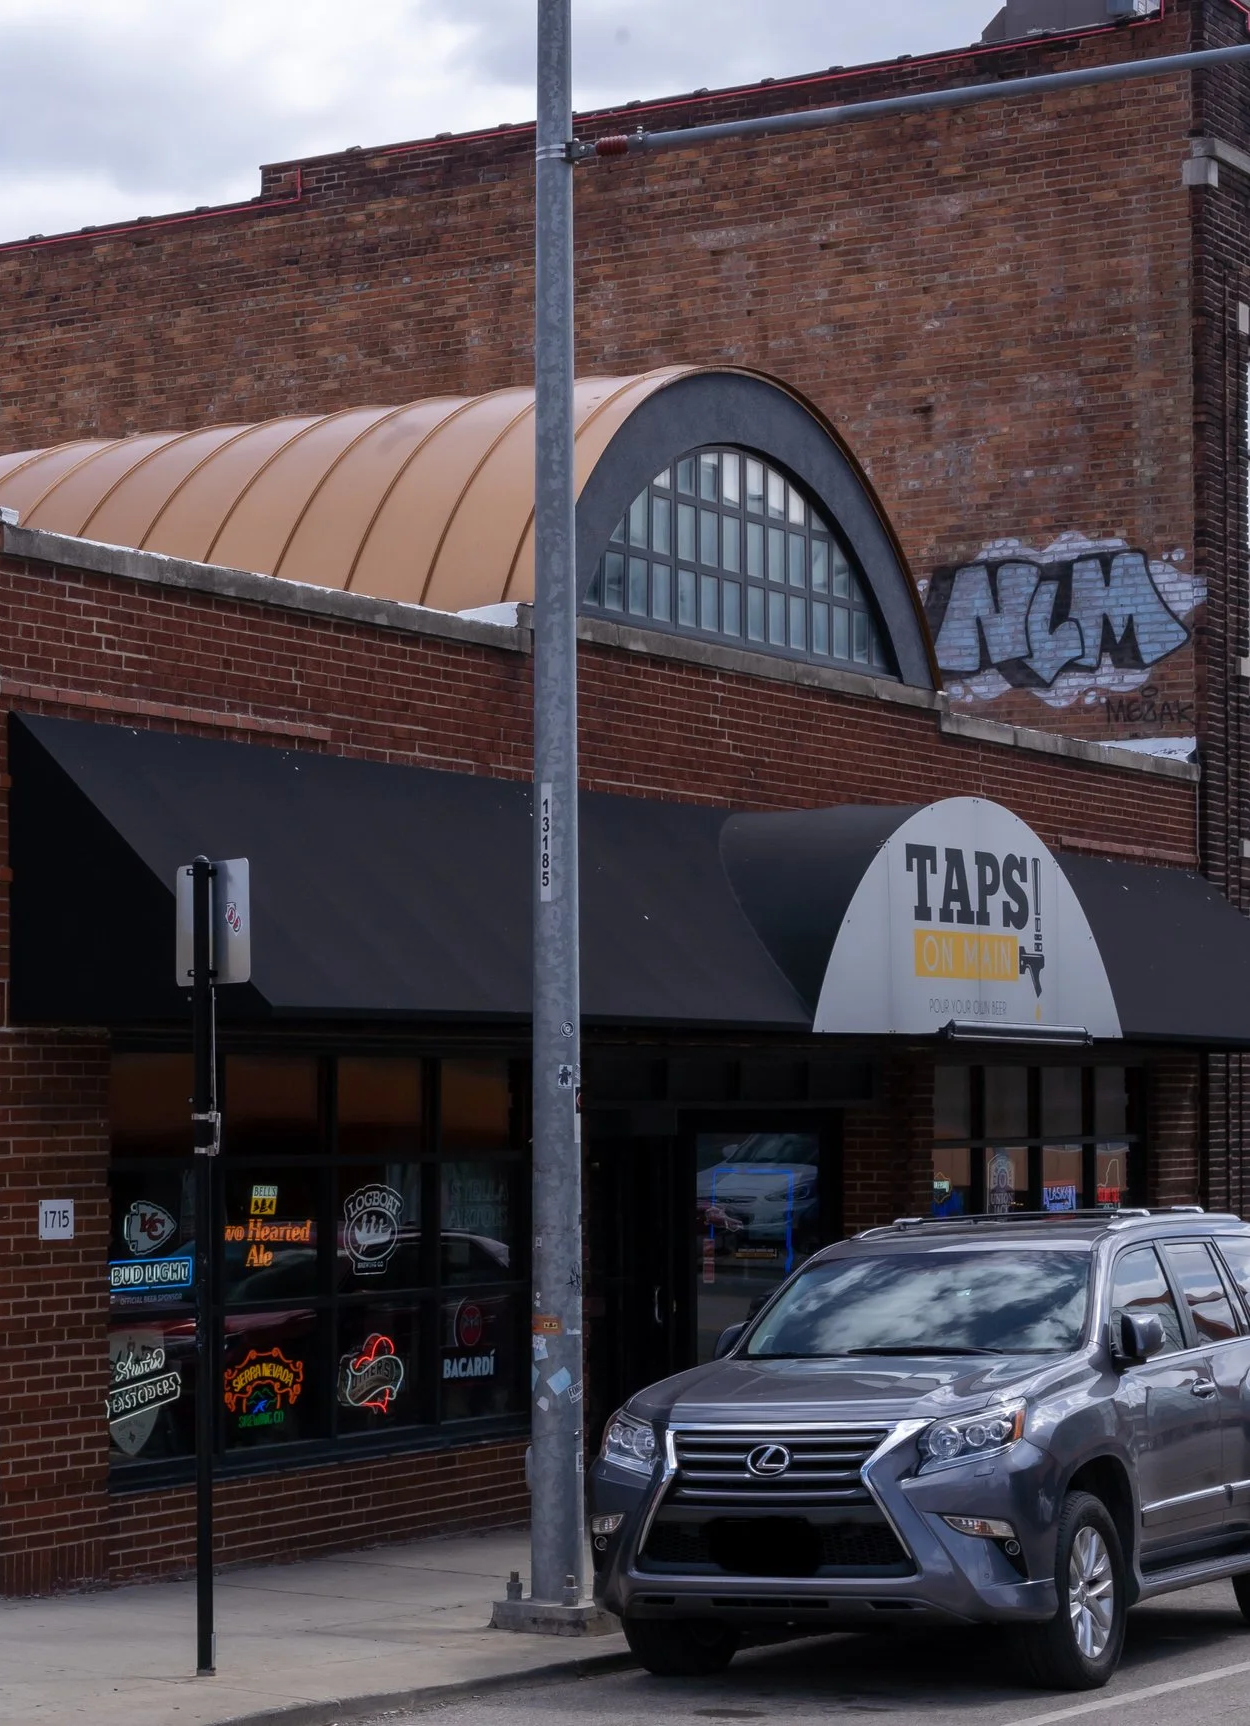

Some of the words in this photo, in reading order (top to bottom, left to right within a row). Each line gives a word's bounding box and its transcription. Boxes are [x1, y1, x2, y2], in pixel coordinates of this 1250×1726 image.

[541, 798, 550, 887] 13185
[923, 934, 955, 973] ON
[963, 937, 1012, 976] MAIN
[991, 1000, 1007, 1015] BEER
[348, 1191, 401, 1218] LOGBOAT
[43, 1210, 70, 1230] 1715
[245, 1243, 274, 1267] Ale
[111, 1266, 143, 1286] BUD
[145, 1261, 190, 1283] LIGHT
[232, 1364, 261, 1392] SIERRA
[262, 1363, 294, 1388] NEVADA
